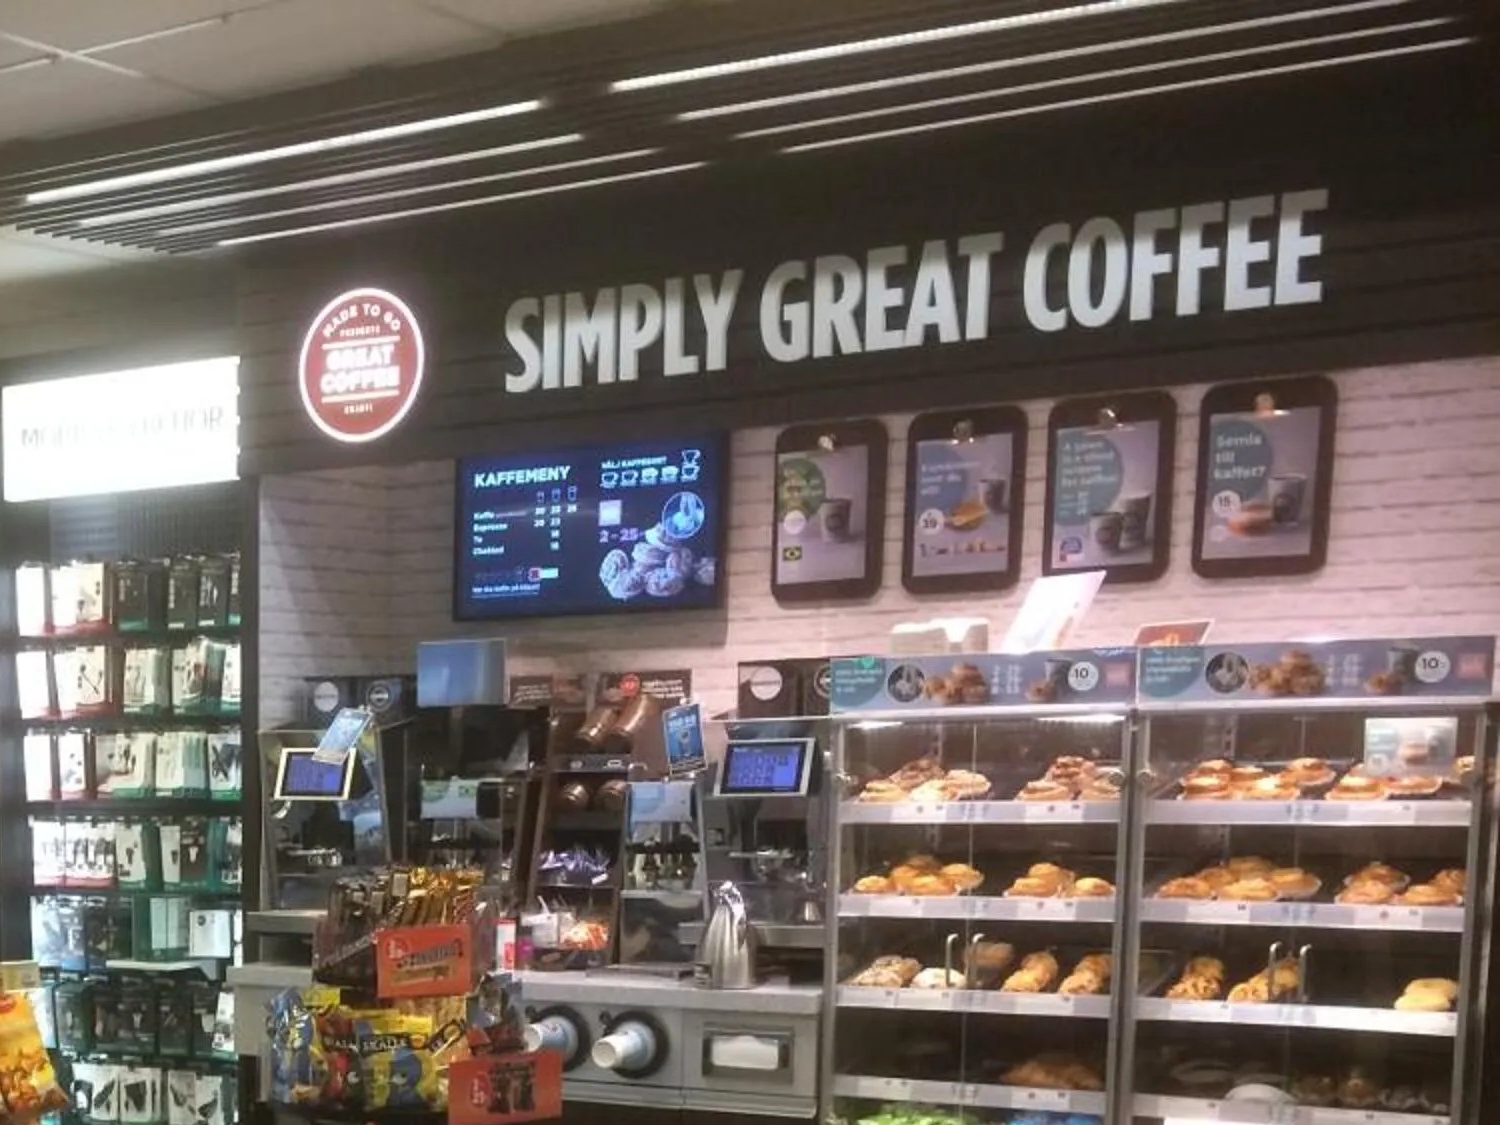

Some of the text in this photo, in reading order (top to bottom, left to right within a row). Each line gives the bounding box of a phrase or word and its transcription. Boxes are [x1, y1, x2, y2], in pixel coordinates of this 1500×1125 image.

[505, 188, 1329, 394] SIMPLY GREAT COFFEE
[363, 303, 381, 317] TO
[325, 343, 395, 371] GREAT
[320, 366, 400, 394] COFFEE
[474, 465, 571, 488] KAFFEMENY
